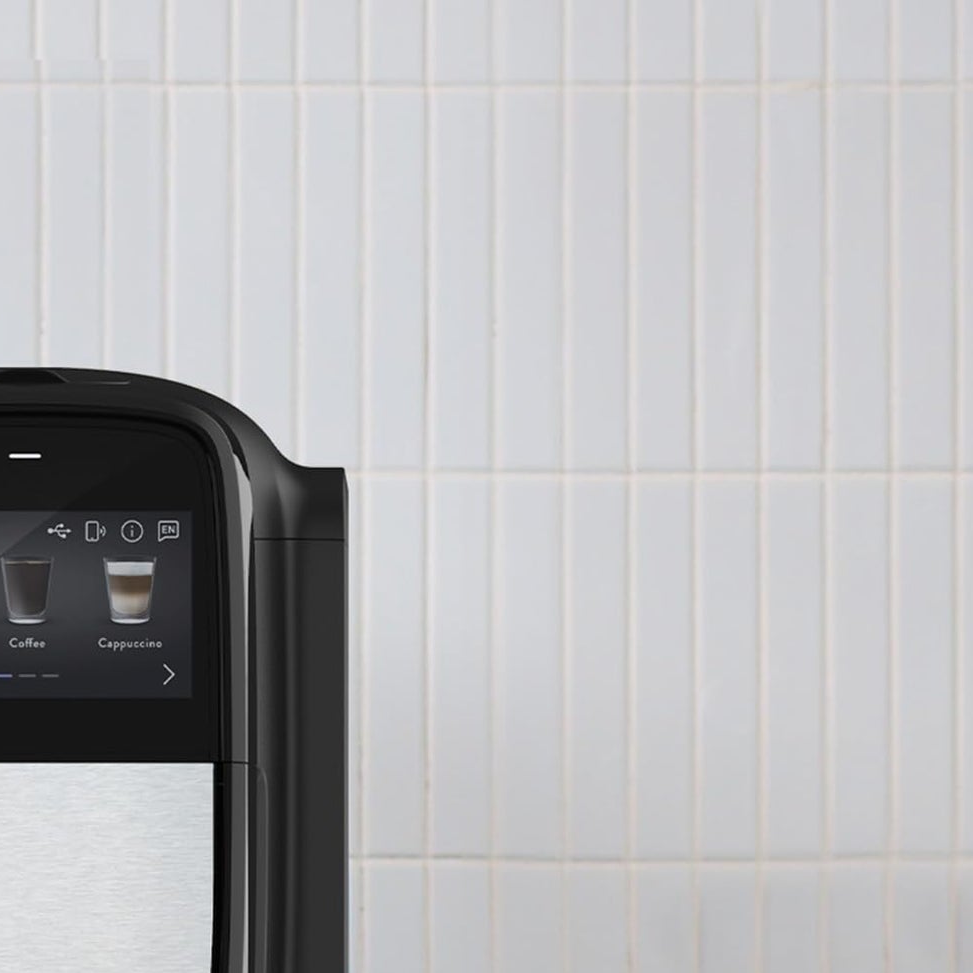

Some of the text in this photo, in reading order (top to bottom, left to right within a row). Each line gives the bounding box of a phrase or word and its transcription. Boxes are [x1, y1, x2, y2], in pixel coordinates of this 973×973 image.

[161, 525, 176, 534] EN
[9, 637, 46, 649] Coffee
[98, 638, 163, 652] Cappuccino
